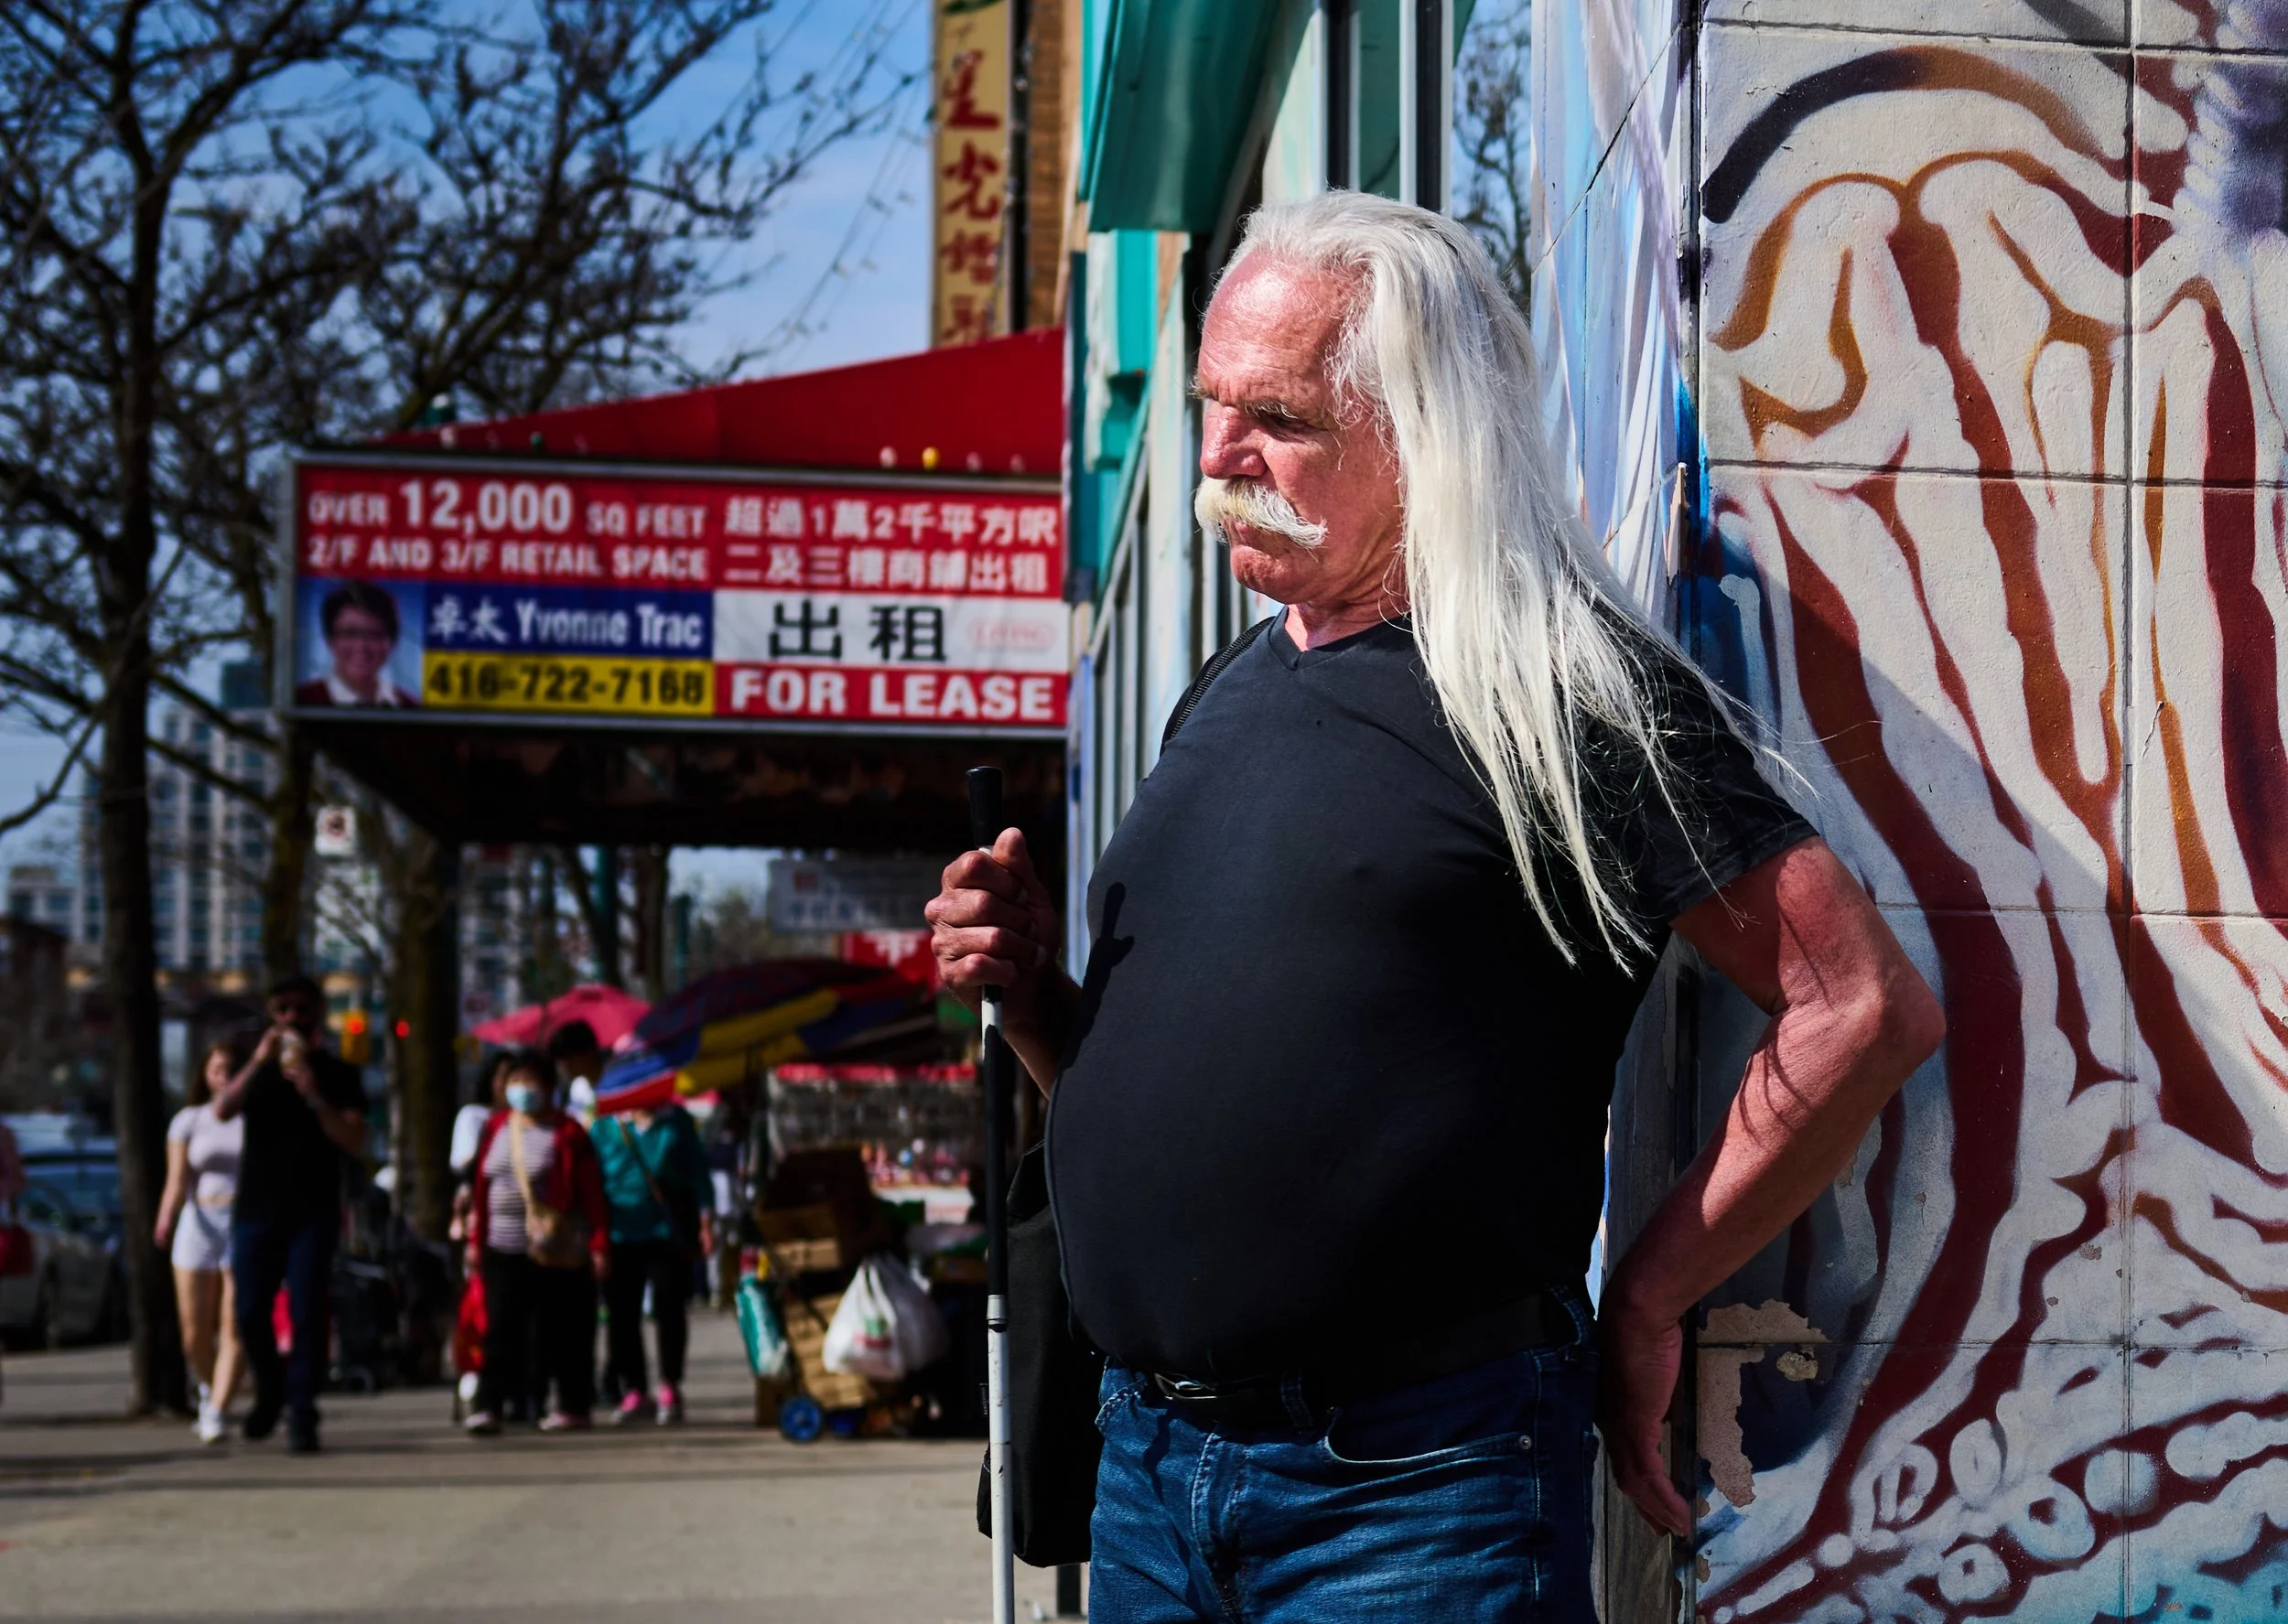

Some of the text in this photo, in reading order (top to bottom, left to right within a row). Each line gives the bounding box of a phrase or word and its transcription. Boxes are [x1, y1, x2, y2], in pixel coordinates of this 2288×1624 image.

[308, 479, 707, 538] OVER 12,000 SQ FEET
[308, 538, 710, 582] 2/F AND 3/F RETAIL SPACE
[514, 599, 630, 647] Yvonne
[635, 603, 704, 650] Trac
[769, 598, 946, 662] 出租
[428, 661, 704, 706] 416-722-7168
[732, 669, 1053, 721] FOR LEASE
